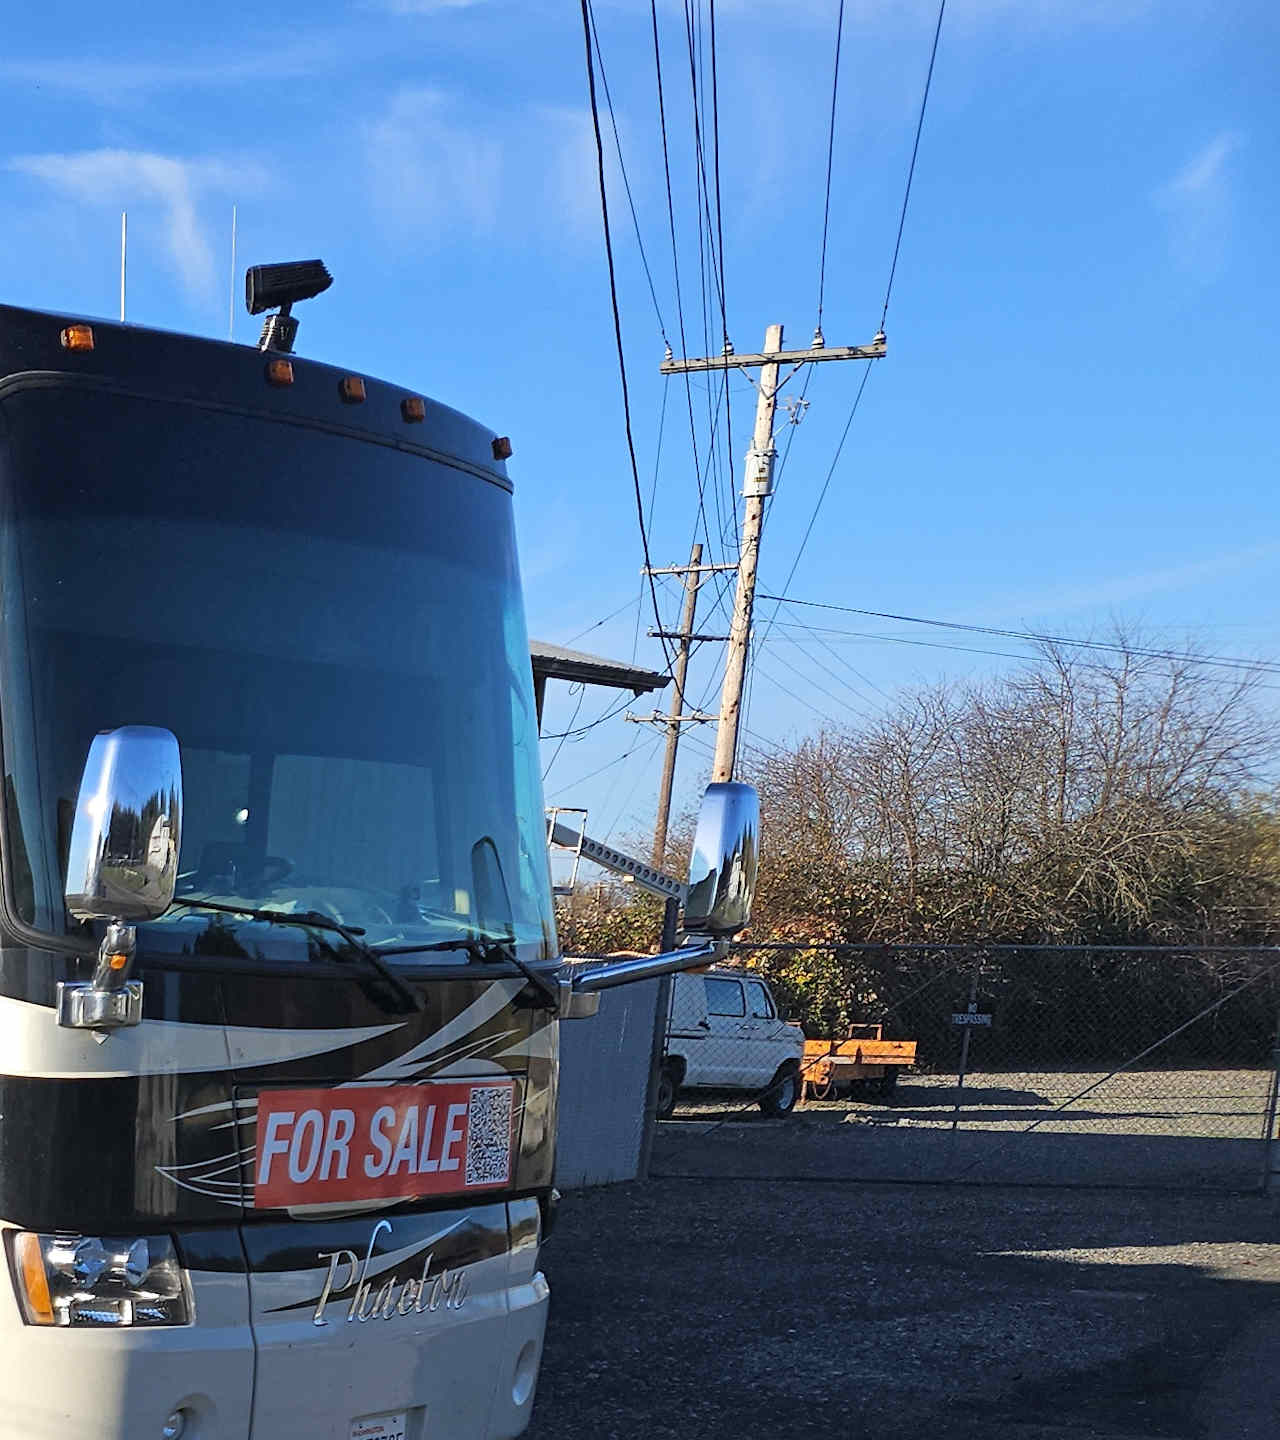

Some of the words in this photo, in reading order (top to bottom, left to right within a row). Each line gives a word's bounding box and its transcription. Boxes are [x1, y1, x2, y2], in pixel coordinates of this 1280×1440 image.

[258, 1109, 355, 1185] FOR
[364, 1103, 467, 1178] SALE
[313, 1219, 470, 1327] Phaeton
